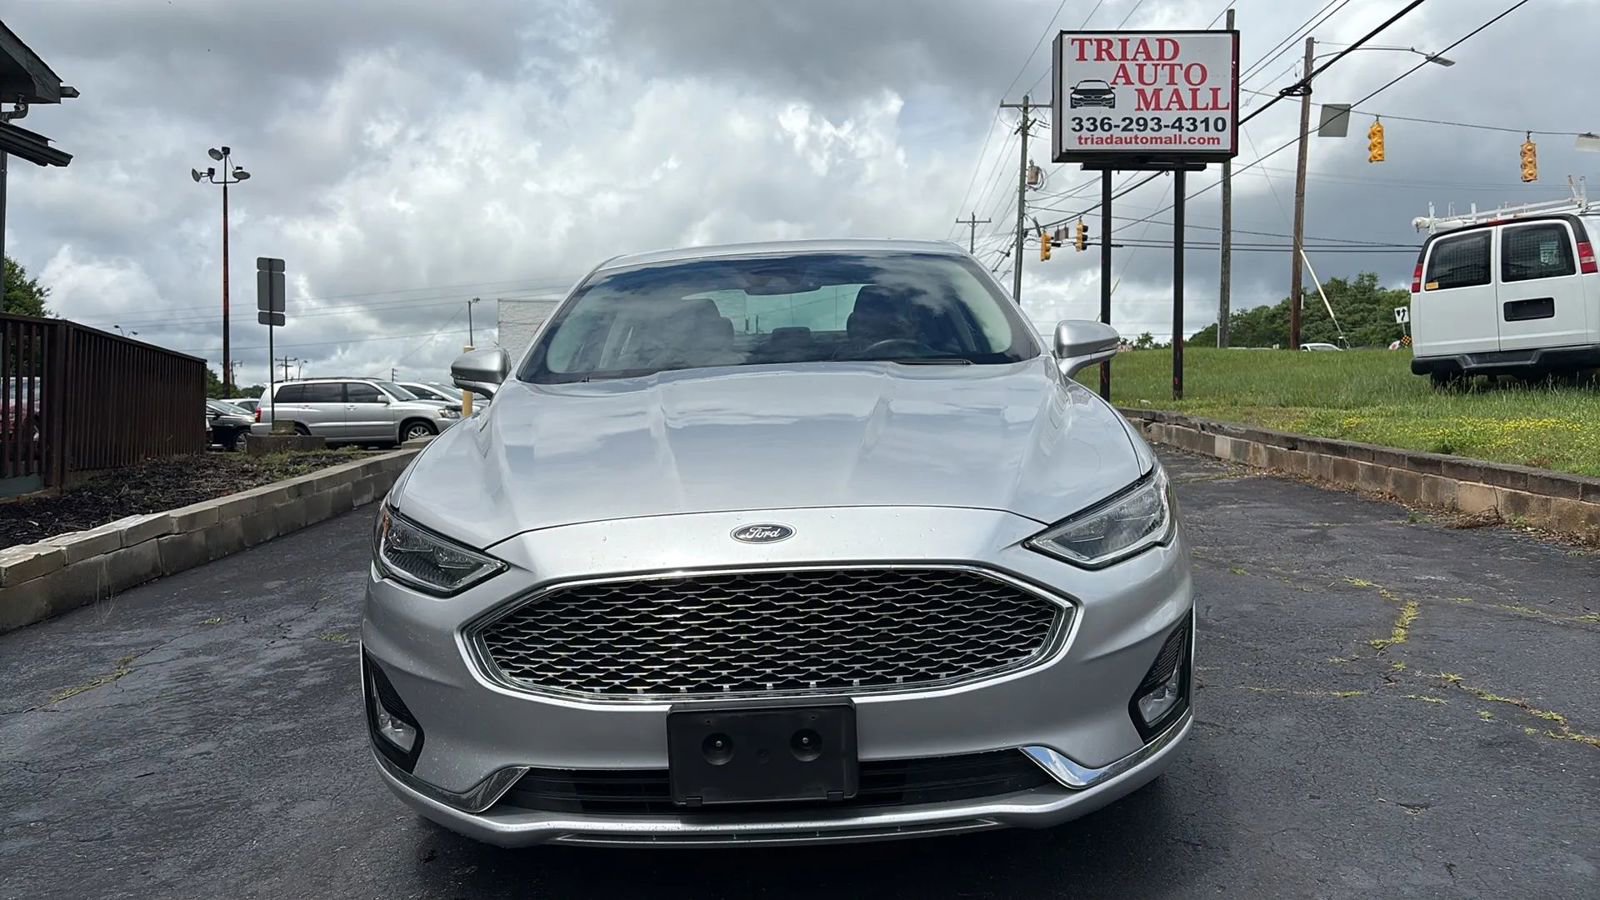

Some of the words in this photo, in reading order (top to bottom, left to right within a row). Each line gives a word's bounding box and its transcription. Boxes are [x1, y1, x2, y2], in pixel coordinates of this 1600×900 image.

[1071, 38, 1180, 62] TRIAD
[1110, 63, 1208, 86] AUTO
[1134, 87, 1230, 112] MALL
[1071, 116, 1227, 133] 336-293-4310
[1077, 134, 1221, 146] triadautomall.com
[740, 526, 781, 539] Ford
